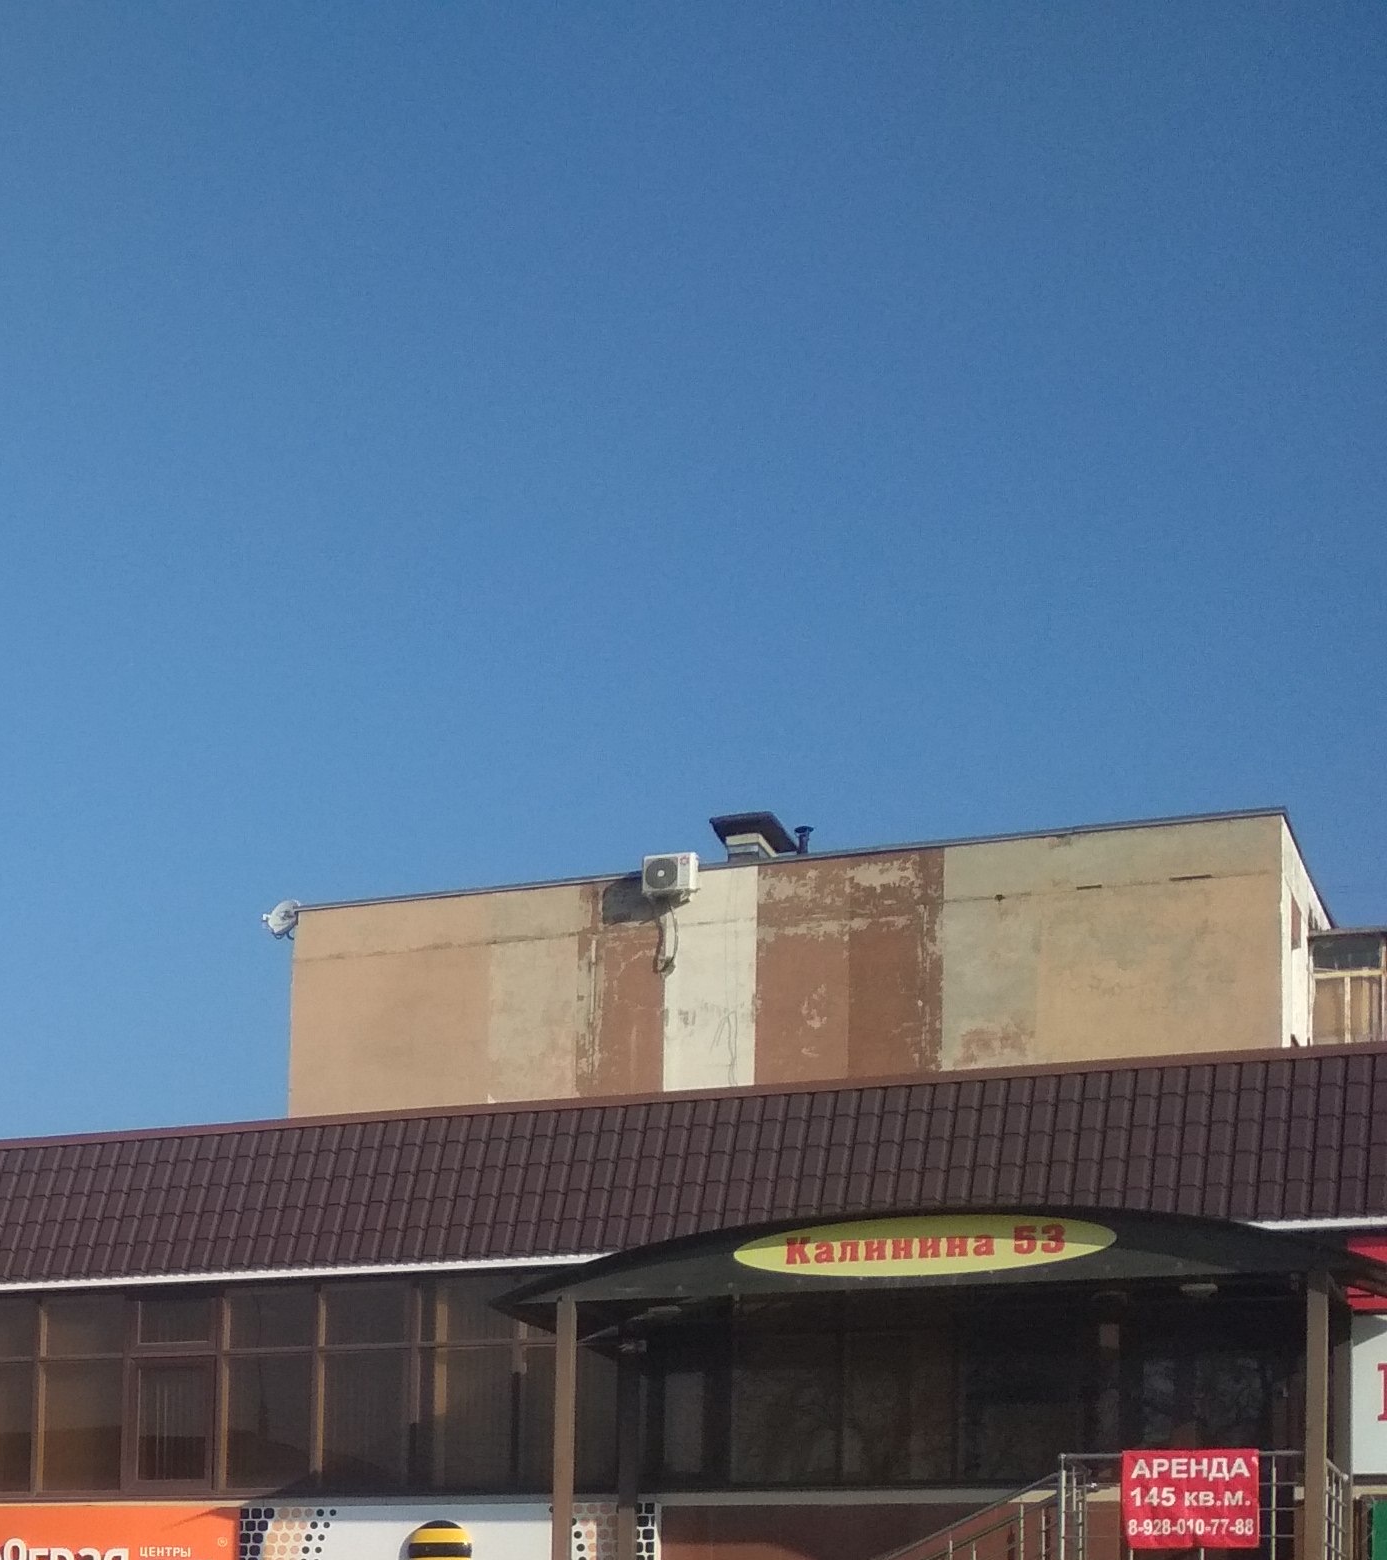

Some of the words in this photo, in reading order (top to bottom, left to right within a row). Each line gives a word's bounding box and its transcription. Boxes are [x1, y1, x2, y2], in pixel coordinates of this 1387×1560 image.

[785, 1234, 994, 1265] Калинина
[1013, 1223, 1067, 1255] 53
[1131, 1457, 1251, 1481] АРЕНДА
[1130, 1486, 1176, 1507] 145
[1184, 1490, 1252, 1507] кв.м.
[1129, 1518, 1255, 1536] 8-928-010-77-88
[139, 1546, 191, 1558] ЦЕНТРЫ
